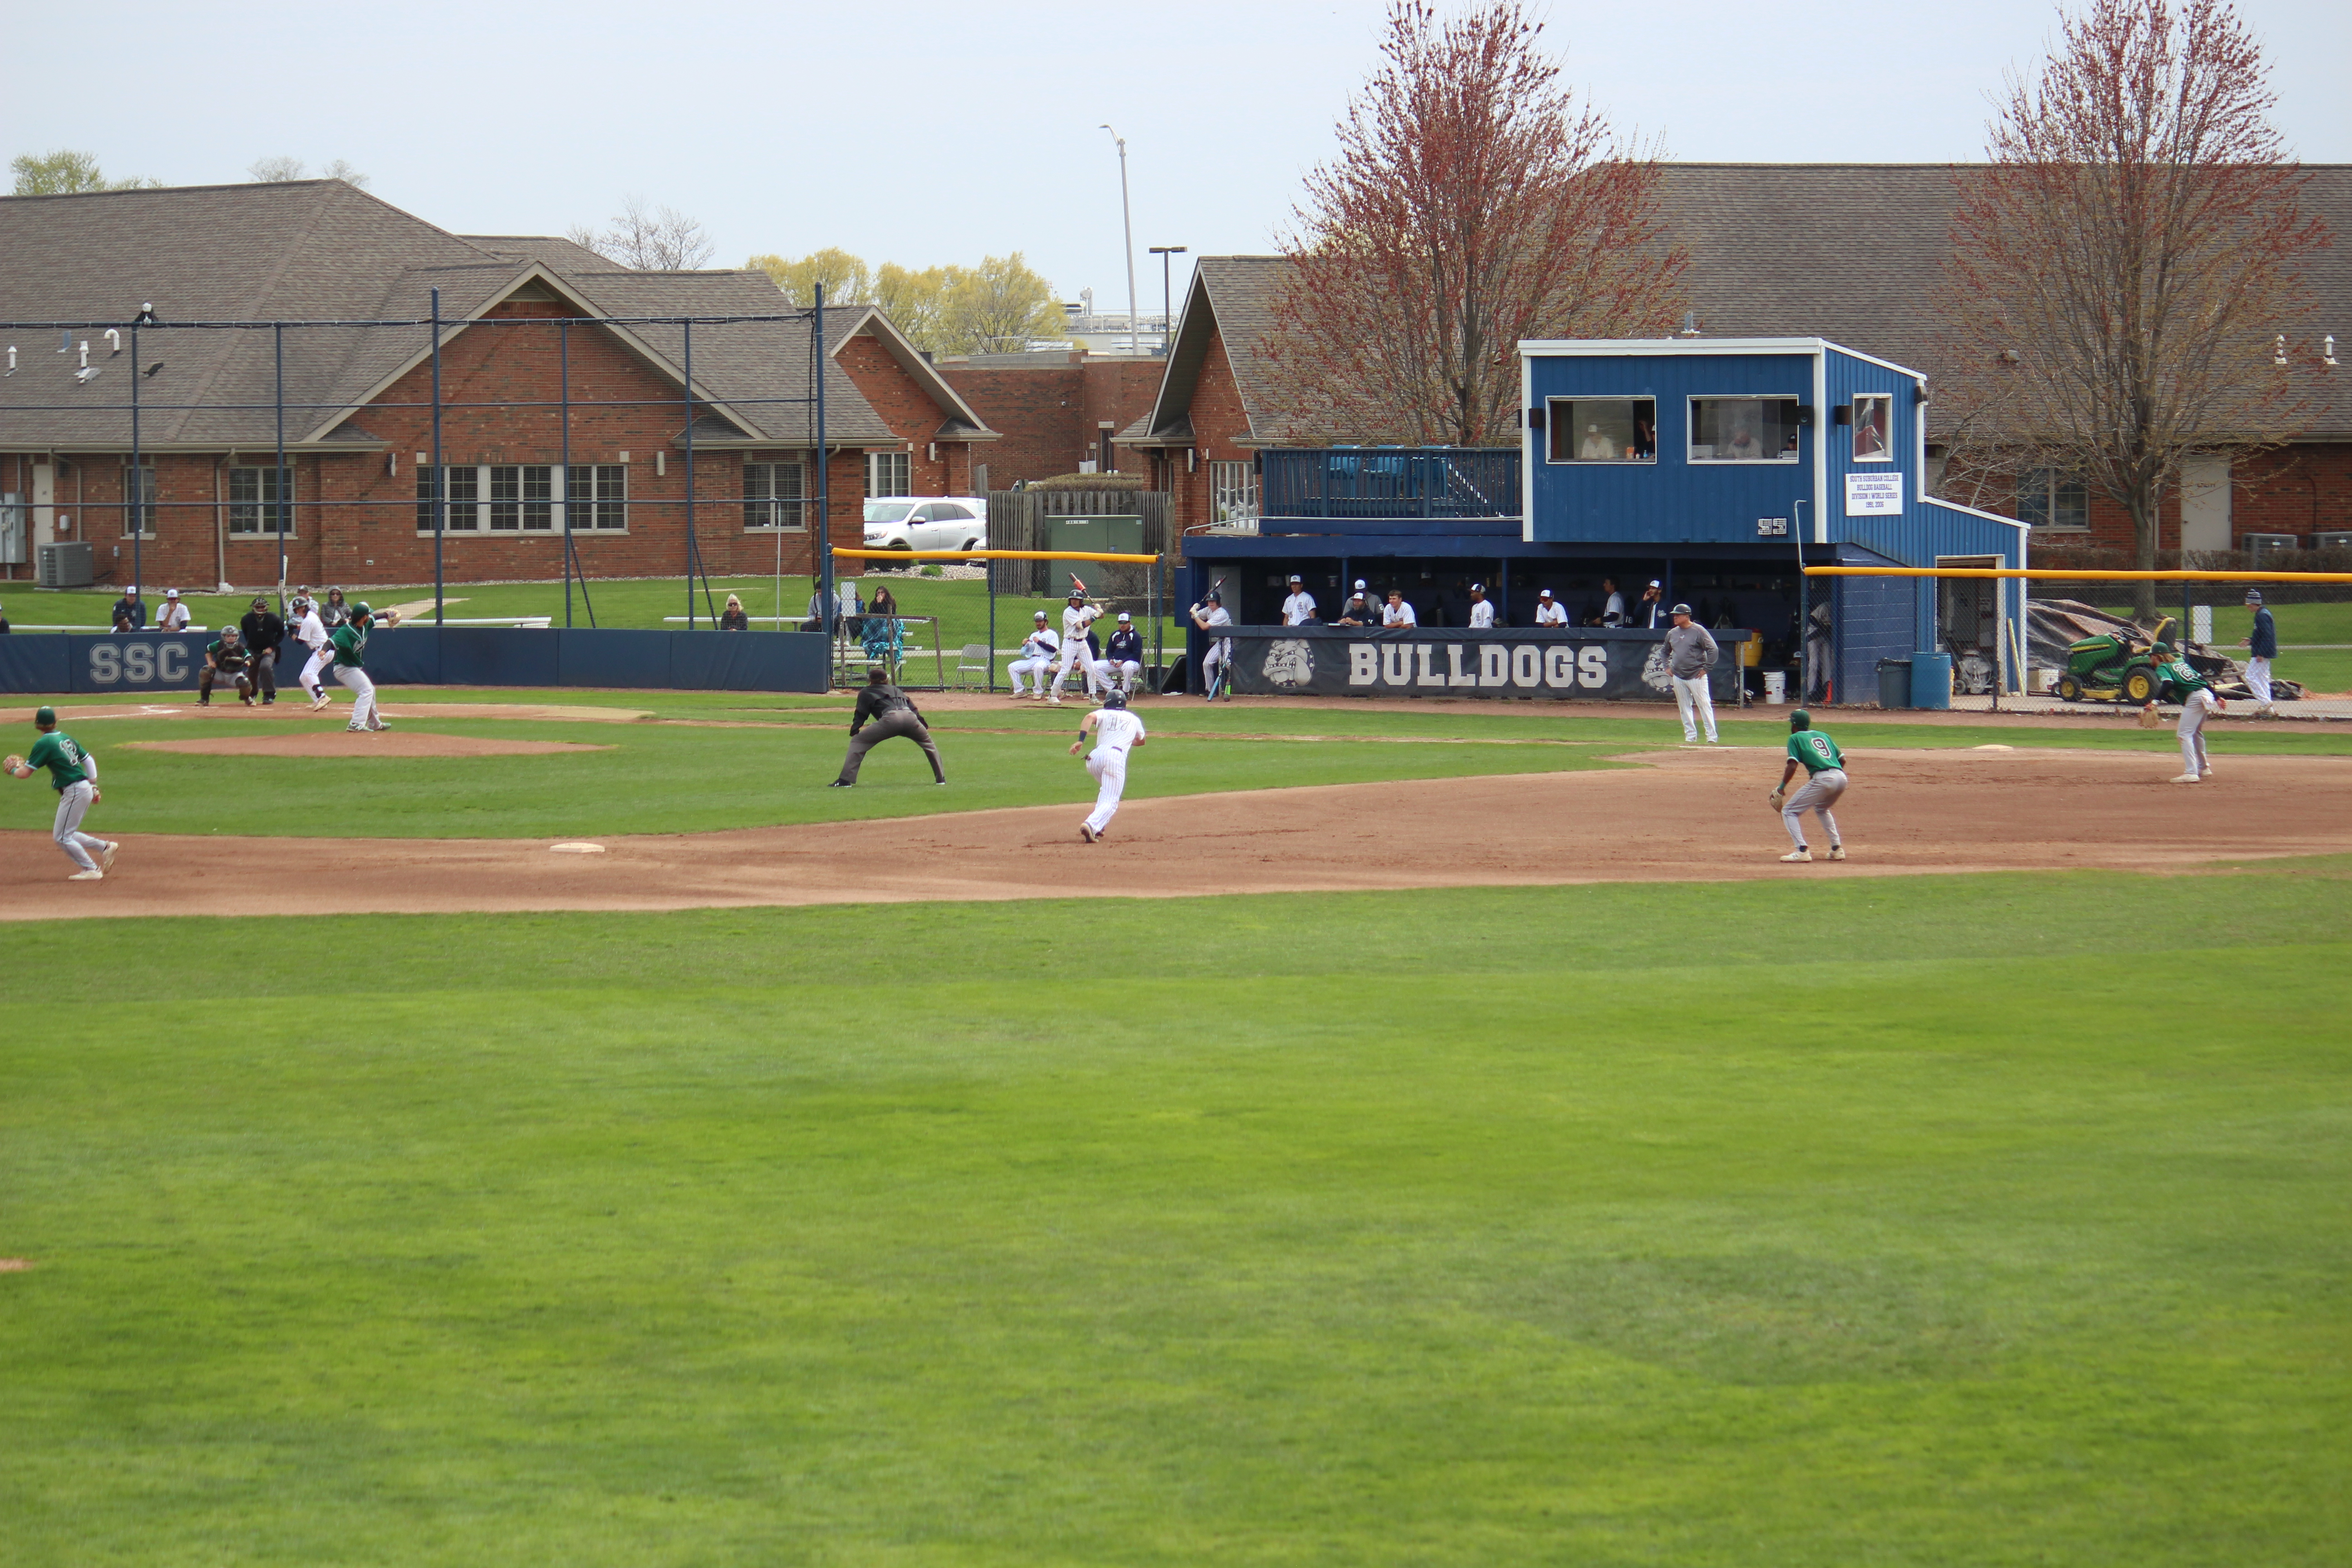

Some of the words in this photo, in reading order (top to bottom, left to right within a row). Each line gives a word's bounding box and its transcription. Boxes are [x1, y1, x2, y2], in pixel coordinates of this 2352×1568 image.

[89, 642, 188, 683] SSC
[1349, 643, 1607, 688] BULLDOGS
[1107, 714, 1131, 731] 17
[1811, 737, 1831, 759] 9
